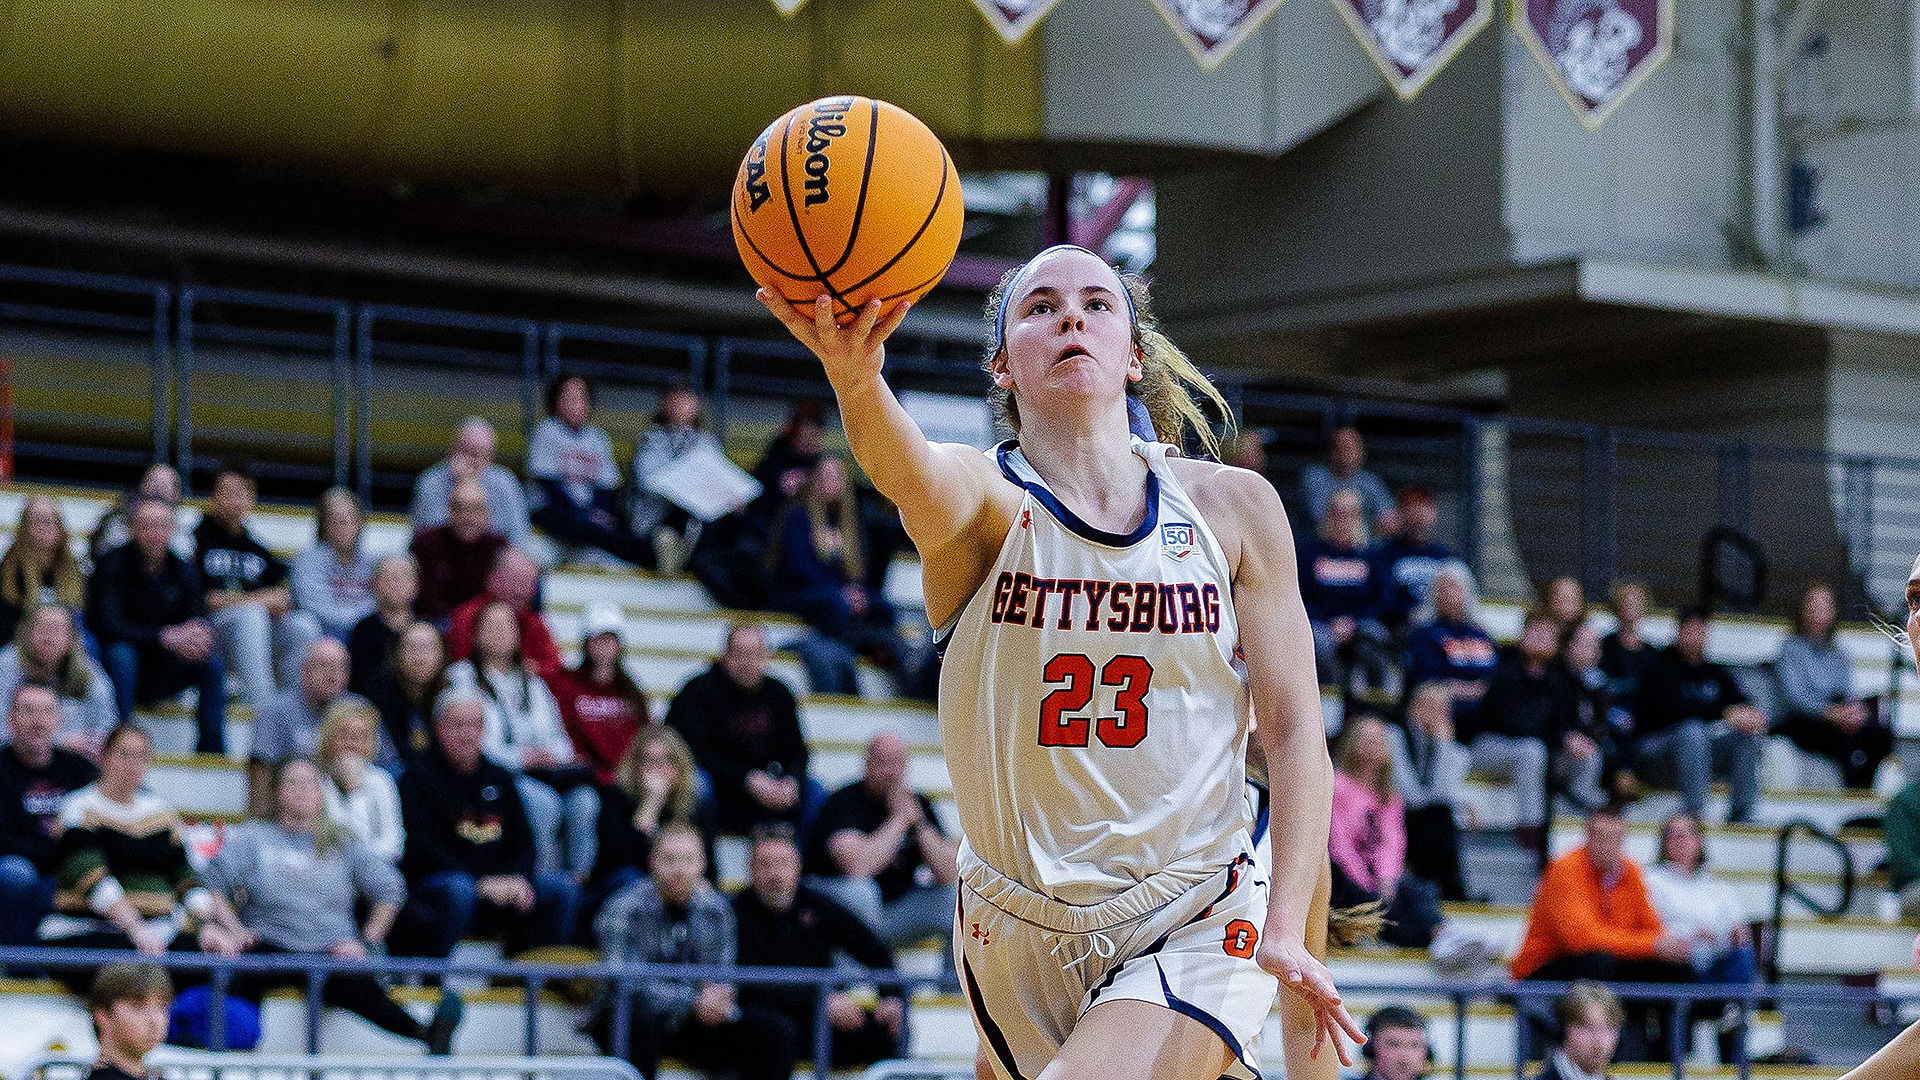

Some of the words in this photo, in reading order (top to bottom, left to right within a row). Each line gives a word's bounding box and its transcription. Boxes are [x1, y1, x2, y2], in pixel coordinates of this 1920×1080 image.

[746, 126, 773, 214] CAA
[1166, 530, 1189, 545] 50
[991, 571, 1221, 634] GETTYSBURG
[1037, 653, 1155, 749] 23
